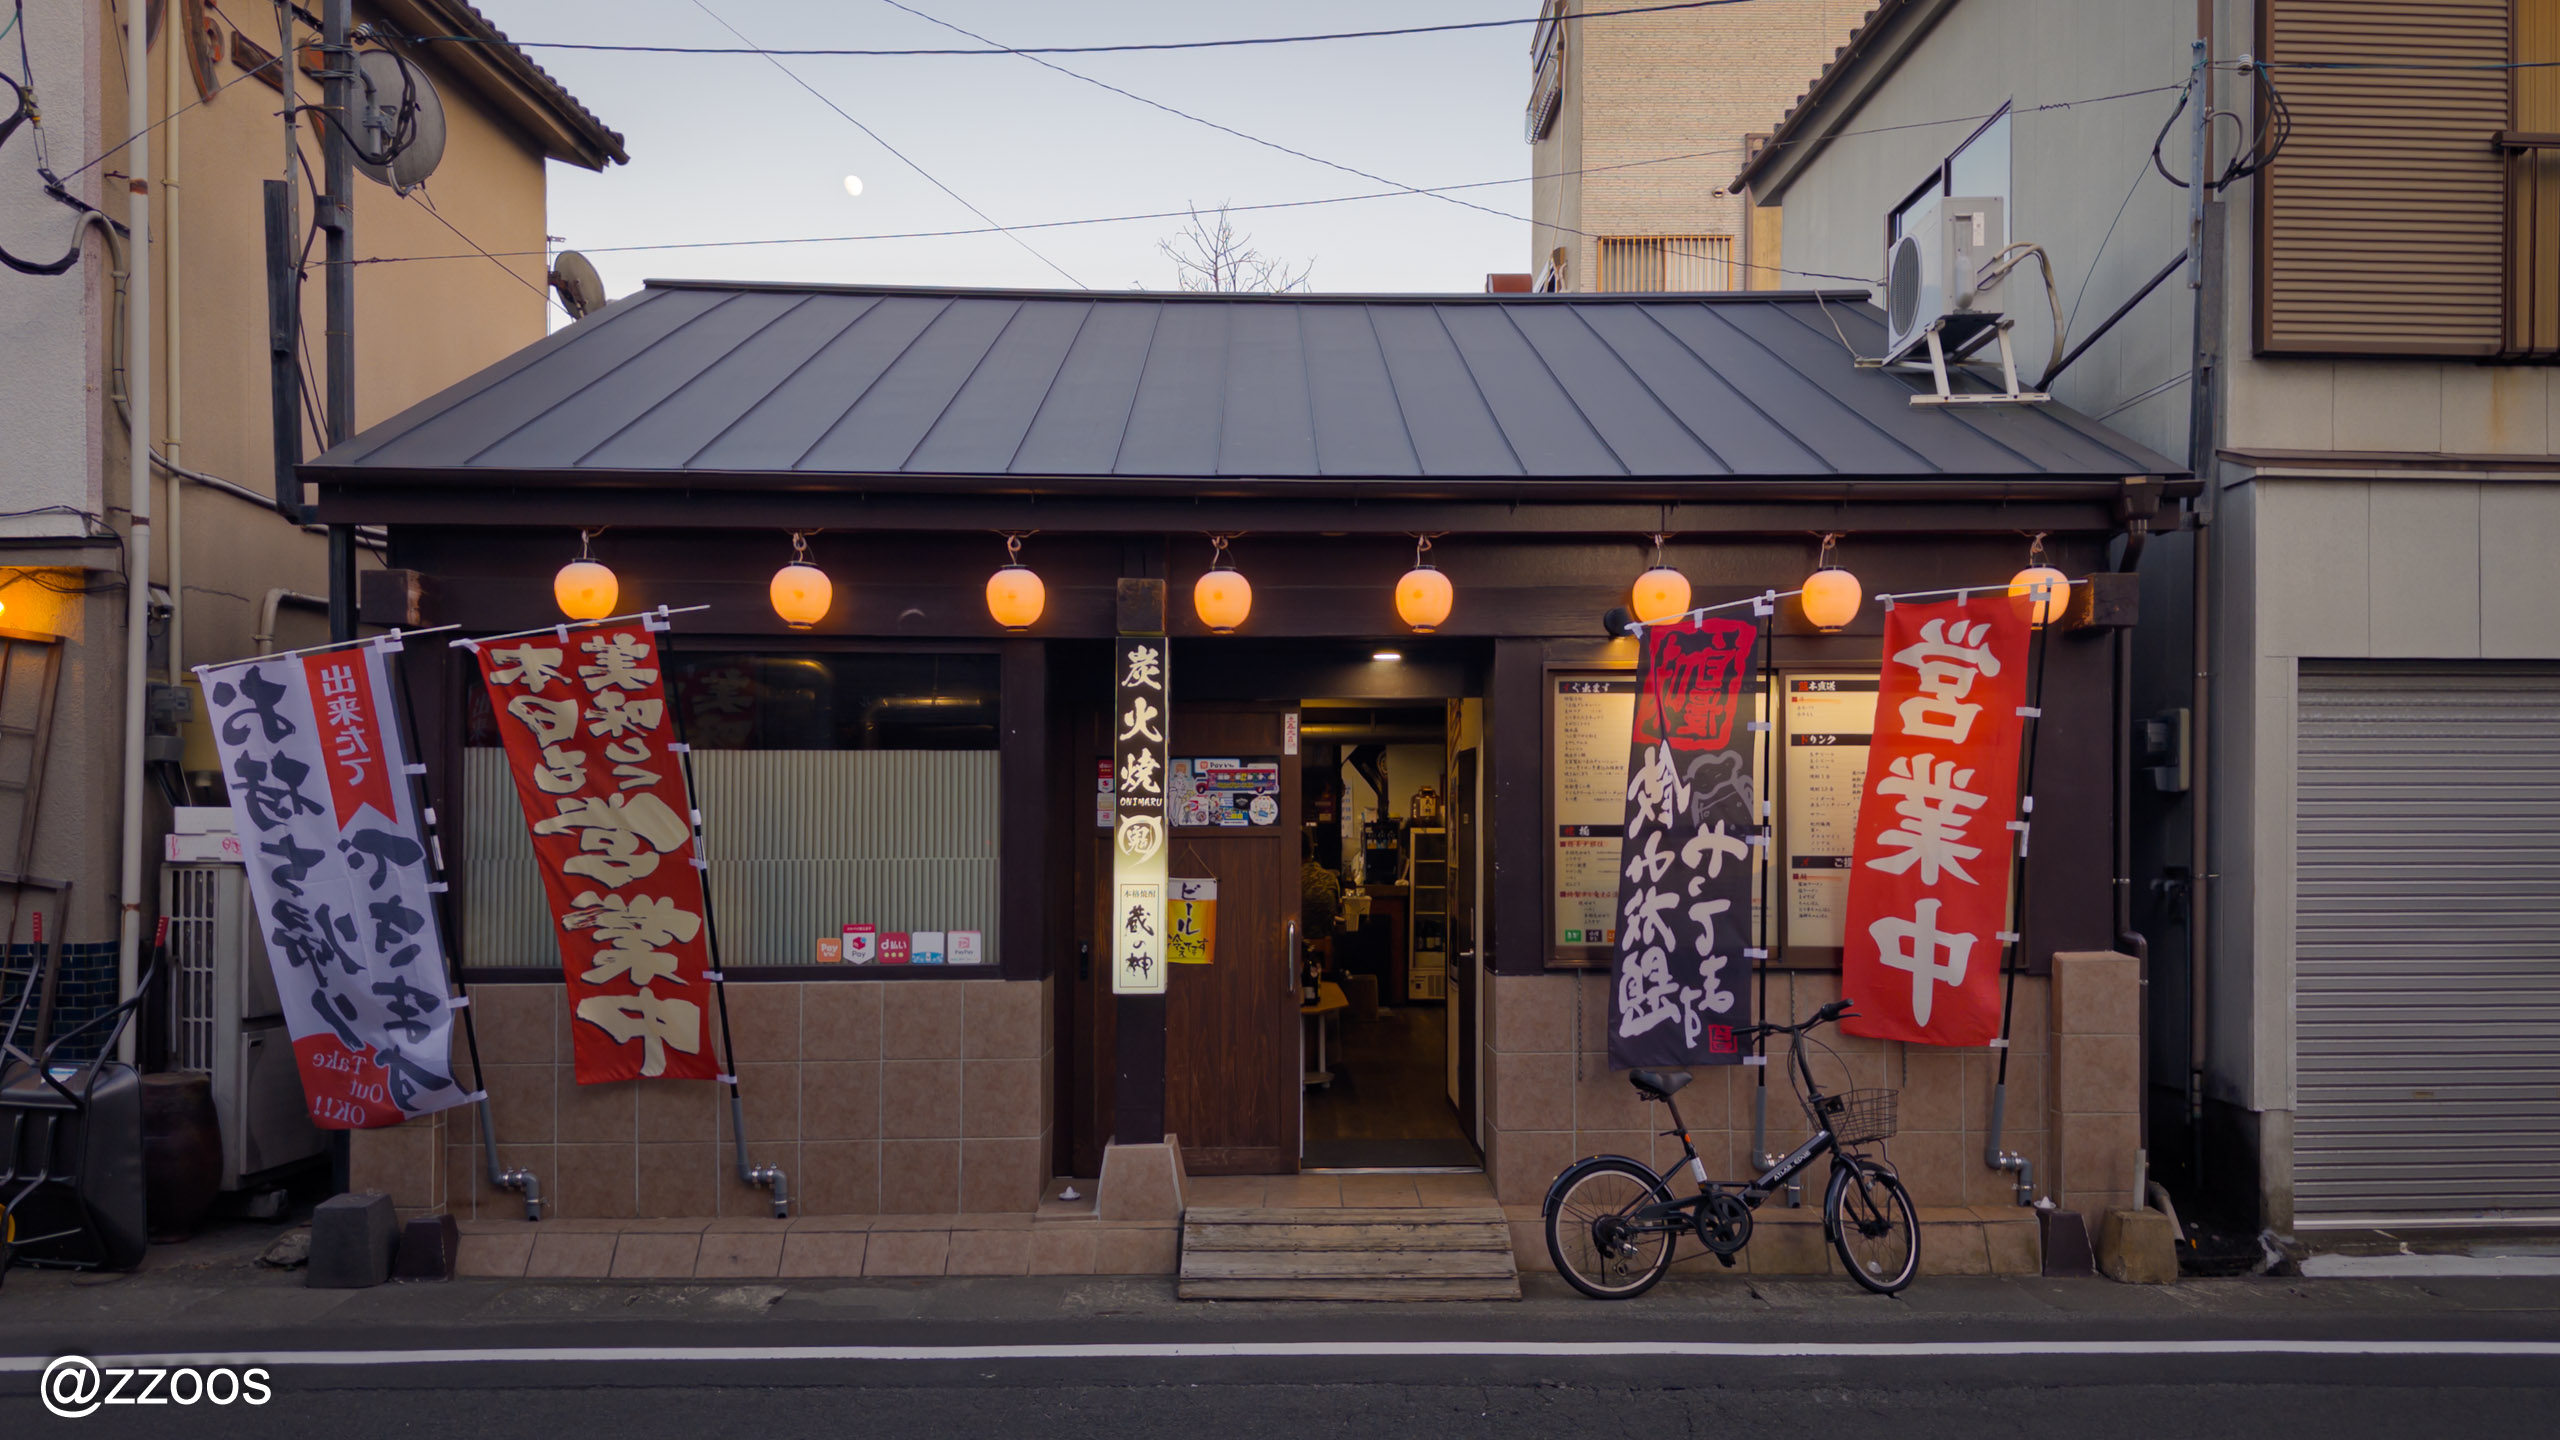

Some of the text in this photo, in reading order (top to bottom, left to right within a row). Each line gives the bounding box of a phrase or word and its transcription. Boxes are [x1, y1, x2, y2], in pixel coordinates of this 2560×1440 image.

[1120, 644, 1163, 793] 炭火焼
[1120, 796, 1163, 808] ONIMARU
[1867, 617, 2000, 1028] 営業中
[1124, 890, 1156, 899] 本格焼酎
[1177, 881, 1201, 935] ビール
[881, 939, 908, 950] d払い
[1125, 904, 1155, 981] 蔵の神
[820, 944, 838, 954] Pay
[852, 950, 867, 959] Pay
